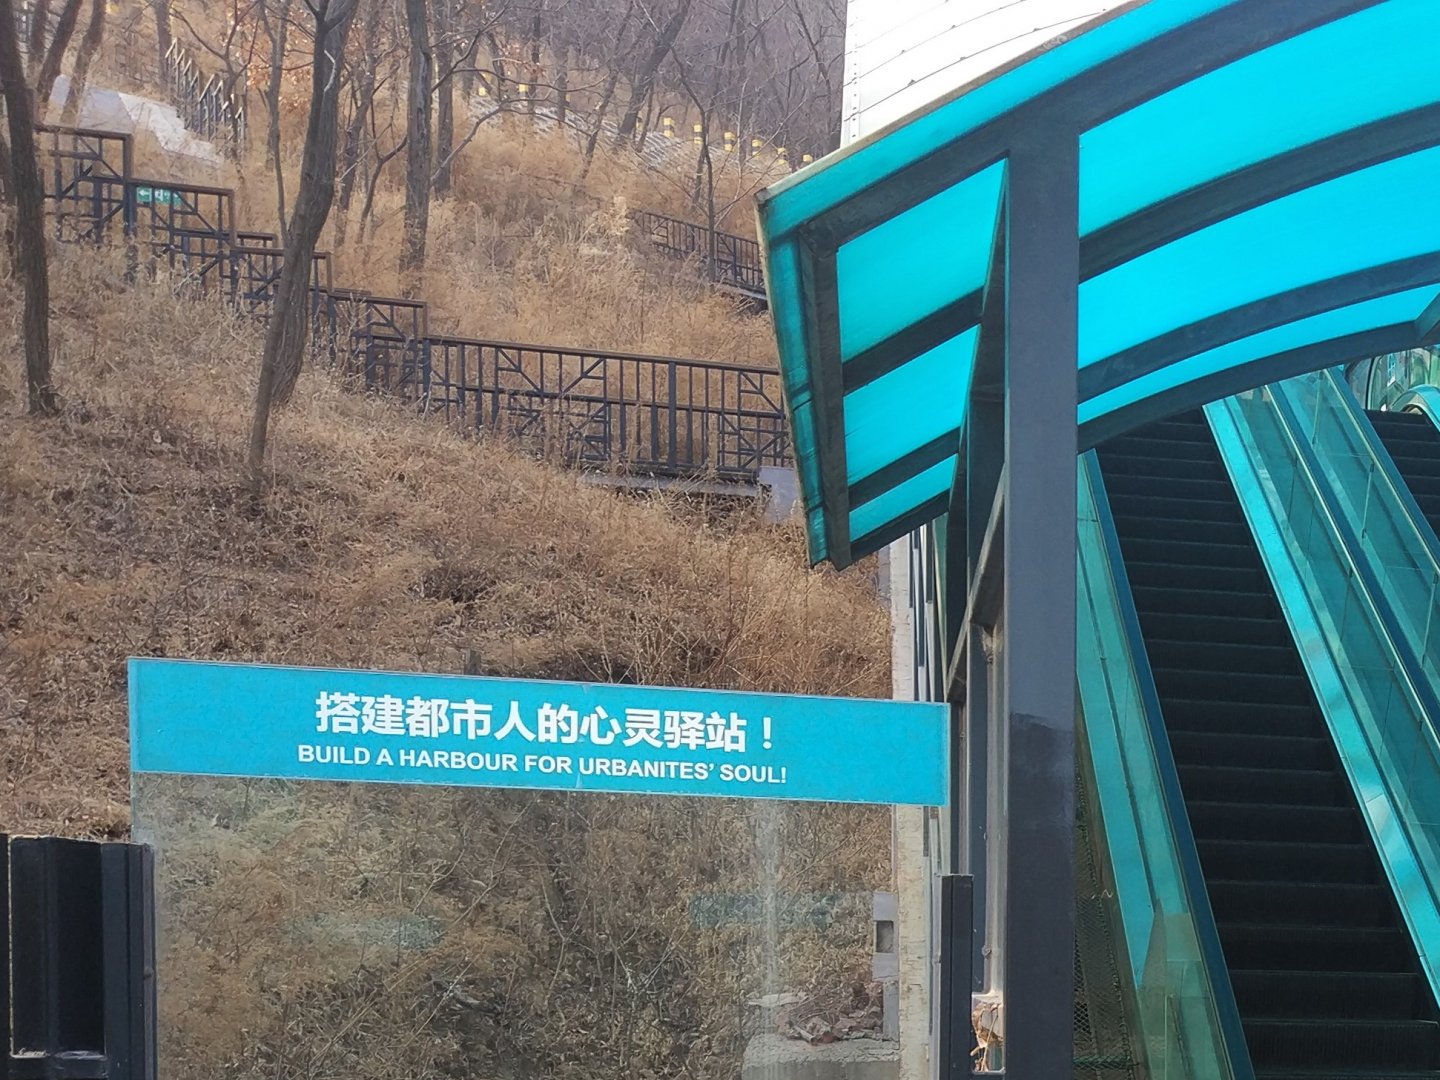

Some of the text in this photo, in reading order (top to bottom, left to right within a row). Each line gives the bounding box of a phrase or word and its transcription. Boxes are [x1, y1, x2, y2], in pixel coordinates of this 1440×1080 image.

[315, 691, 773, 752] 搭建都市人的心灵驿站！
[298, 744, 370, 765] BUILD
[376, 748, 394, 766] A
[400, 749, 519, 772] HARBOUR
[524, 755, 572, 774] FOR
[719, 763, 787, 784] SOUL!
